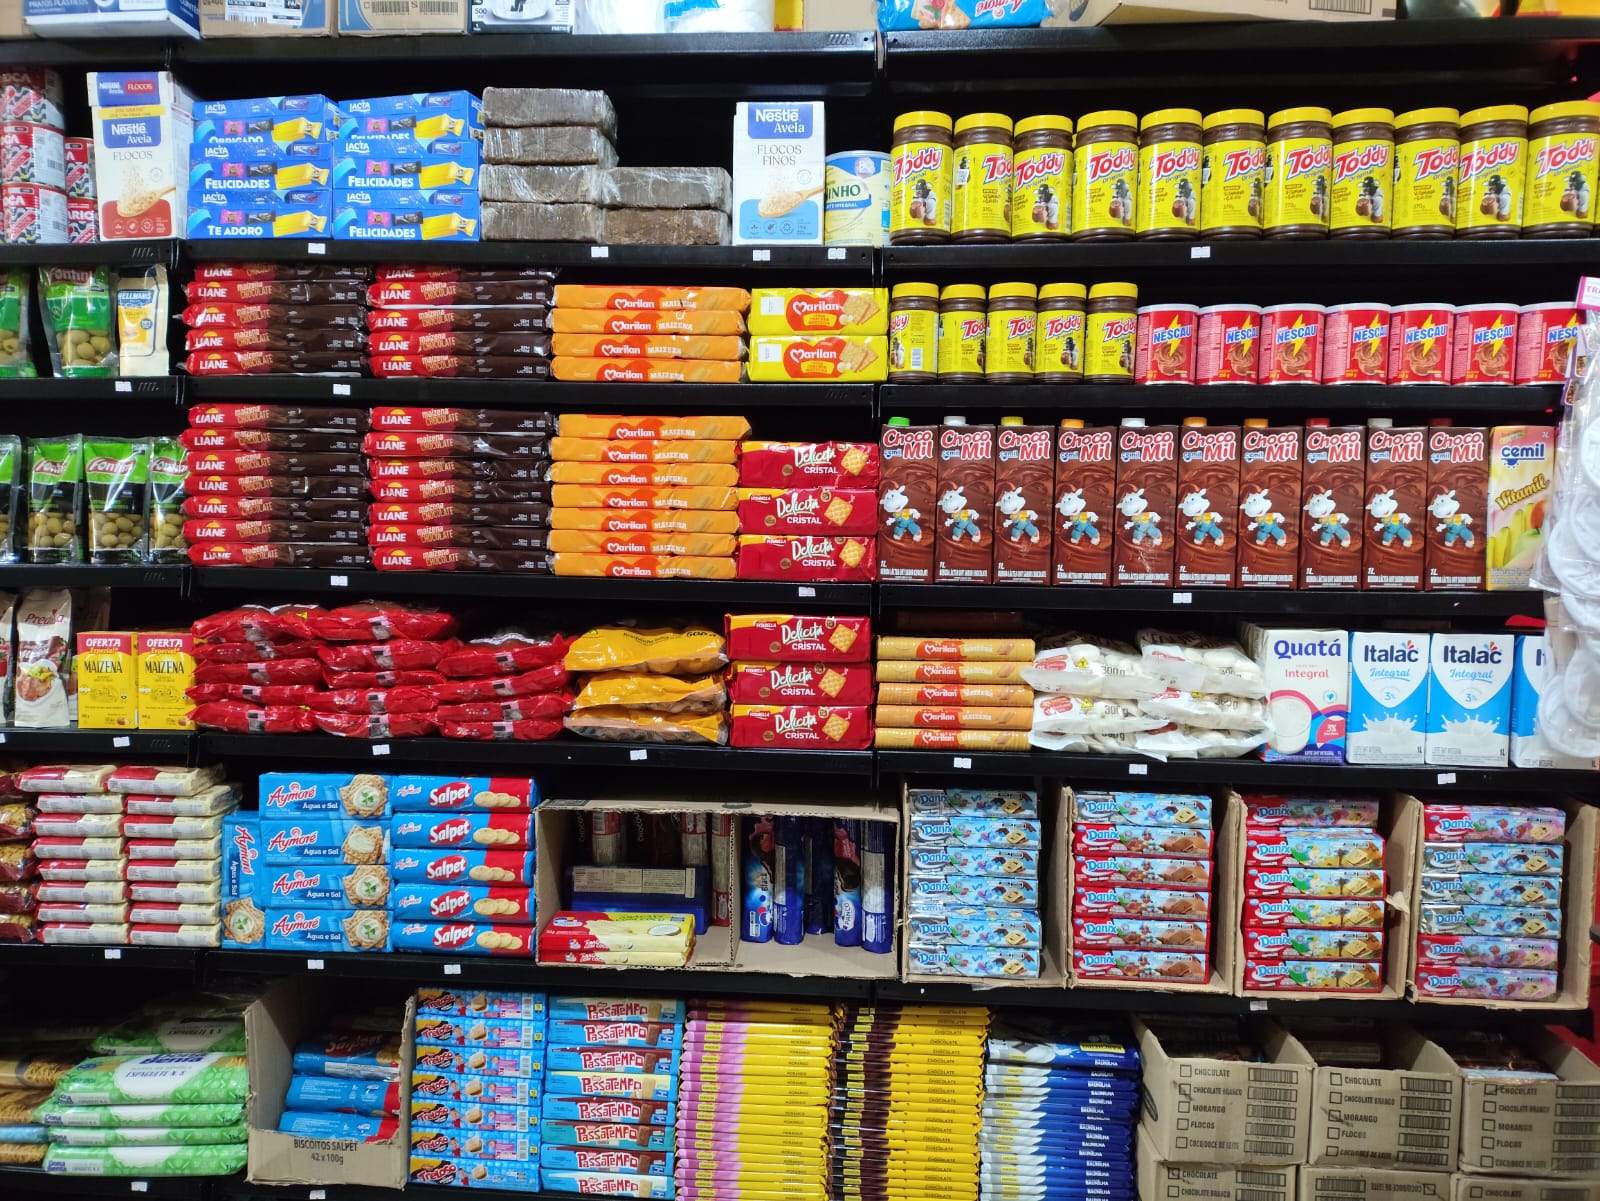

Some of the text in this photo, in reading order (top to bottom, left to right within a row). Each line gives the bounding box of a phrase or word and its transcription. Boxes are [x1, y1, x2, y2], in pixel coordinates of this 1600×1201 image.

[204, 102, 226, 114] LACTA
[350, 100, 370, 113] LACTA
[774, 123, 805, 133] Aveia
[127, 135, 152, 144] Aveia
[205, 146, 229, 158] LACTA
[346, 140, 370, 153] LACTA
[757, 145, 802, 154] FLOCOS
[113, 151, 153, 160] FLOCOS
[762, 156, 796, 165] FINOS
[1536, 138, 1598, 179] Toddy
[894, 147, 943, 185] Toddy
[1087, 148, 1138, 183] Toddy
[1150, 146, 1201, 185] Toddy
[1333, 144, 1390, 185] Toddy
[1459, 141, 1521, 185] Toddy
[1015, 153, 1064, 191] Toddy
[205, 178, 270, 189] FELICIDADES
[348, 176, 414, 188] FELICIDADES
[203, 194, 227, 205] LACTA
[347, 191, 371, 203] LACTA
[208, 225, 263, 235] TE ADORO
[349, 227, 416, 238] FELICIDADES
[198, 288, 227, 297] LIANE
[381, 291, 411, 299] LIANE
[615, 299, 655, 309] Marilan
[377, 318, 408, 327] LIANE
[611, 321, 651, 331] Marilan
[1153, 324, 1192, 344] NESCAU
[1276, 325, 1318, 344] NESCAU
[1405, 324, 1449, 344] NESCAU
[1474, 325, 1514, 344] NESCAU
[379, 342, 409, 350] LIANE
[601, 345, 640, 355] Marilan
[383, 362, 412, 370] LIANE
[196, 414, 224, 423] LIANE
[381, 416, 411, 424] LIANE
[424, 412, 459, 425] CHOCOLATE
[616, 429, 654, 438] Marilan
[194, 436, 224, 445] LIANE
[376, 441, 406, 450] LIANE
[608, 451, 648, 461] Marilan
[961, 441, 992, 460] Mil
[1019, 441, 1051, 461] Mil
[1080, 443, 1111, 462] Mil
[1141, 443, 1174, 462] Mil
[1203, 442, 1236, 462] Mil
[1264, 443, 1298, 462] Mil
[1390, 442, 1423, 462] Mil
[1451, 442, 1484, 462] Mil
[1502, 444, 1545, 458] cemil
[199, 481, 228, 490] LIANE
[1496, 473, 1550, 510] Vitamil
[379, 512, 408, 520] LIANE
[609, 520, 647, 530] Marilan
[383, 556, 412, 565] LIANE
[86, 639, 121, 647] OFERTA
[146, 639, 183, 647] OFERTA
[1273, 638, 1341, 659] Quatá
[925, 644, 957, 655] Marilan
[1364, 645, 1419, 663] Italac
[1443, 645, 1502, 664] Italac
[84, 661, 123, 674] MAIZENA
[145, 661, 184, 674] MAIZENA
[1369, 668, 1411, 679] Integral
[1285, 669, 1329, 679] Integral
[1450, 668, 1493, 680] Integral
[922, 711, 955, 722] Marilan
[268, 786, 317, 807] Aymoré
[429, 785, 471, 805] Salpet
[1088, 800, 1119, 812] Danix
[1441, 819, 1473, 831] Danix
[430, 821, 470, 842] Salpet
[1088, 829, 1119, 841] Danix
[268, 831, 318, 852] Aymoré
[1436, 851, 1467, 863] Danix
[426, 858, 467, 880] Salpet
[1087, 860, 1118, 872] Danix
[272, 874, 320, 895] Aymoré
[1260, 873, 1292, 884] Danix
[1087, 891, 1118, 903] Danix
[430, 893, 471, 915] Salpet
[272, 916, 320, 936] Aymoré
[433, 924, 475, 945] Salpet
[1085, 953, 1115, 966] Danix
[1194, 1068, 1230, 1078] CHOCOLATE
[1344, 1076, 1382, 1086] CHOCOLATE
[1192, 1105, 1226, 1113] MORANGO
[1343, 1114, 1378, 1123] MORANGO
[1342, 1131, 1366, 1139] FLOCOS
[294, 1139, 357, 1152] BISCOITOS SALPET
[311, 1153, 320, 1162] 42
[327, 1153, 344, 1165] 100g
[1182, 1171, 1218, 1180] CHOCOLATE
